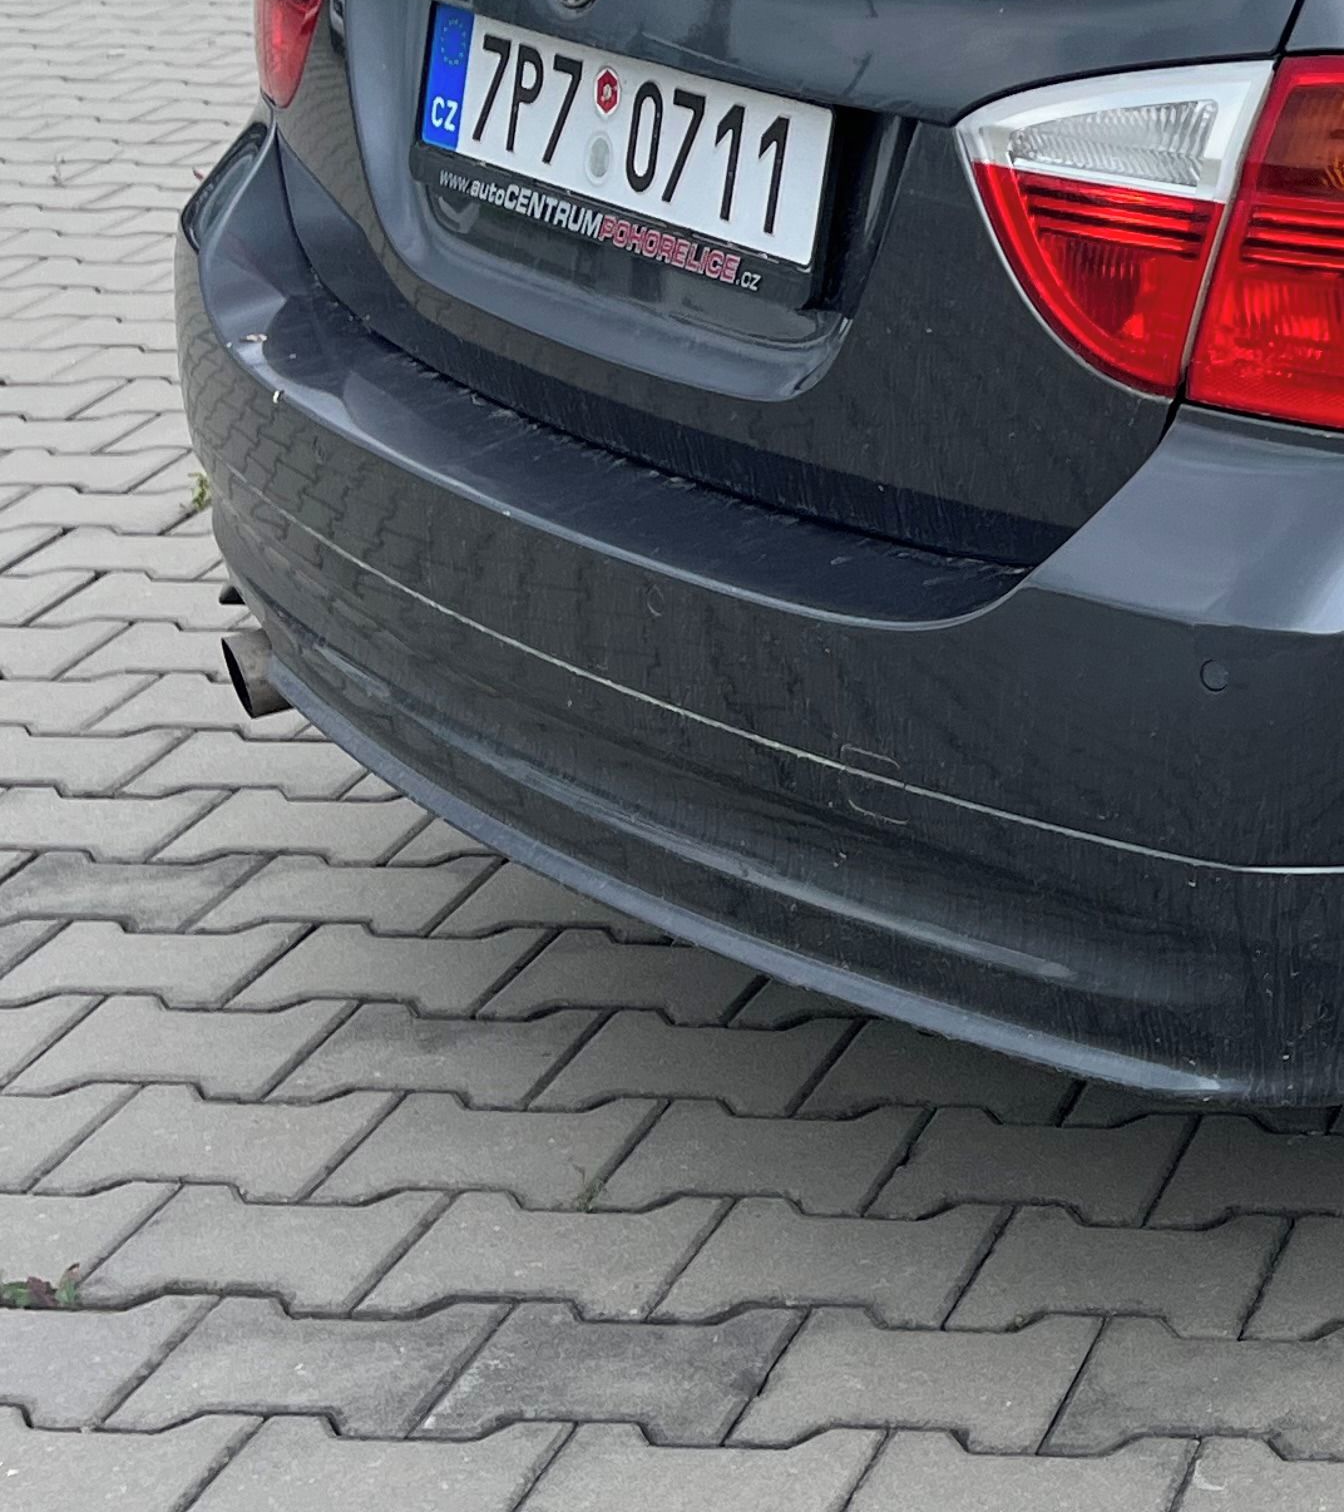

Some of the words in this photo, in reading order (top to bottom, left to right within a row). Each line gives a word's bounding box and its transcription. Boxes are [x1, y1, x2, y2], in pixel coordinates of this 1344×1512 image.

[430, 96, 457, 133] CZ
[472, 33, 584, 165] 7P7
[625, 81, 791, 236] 0711
